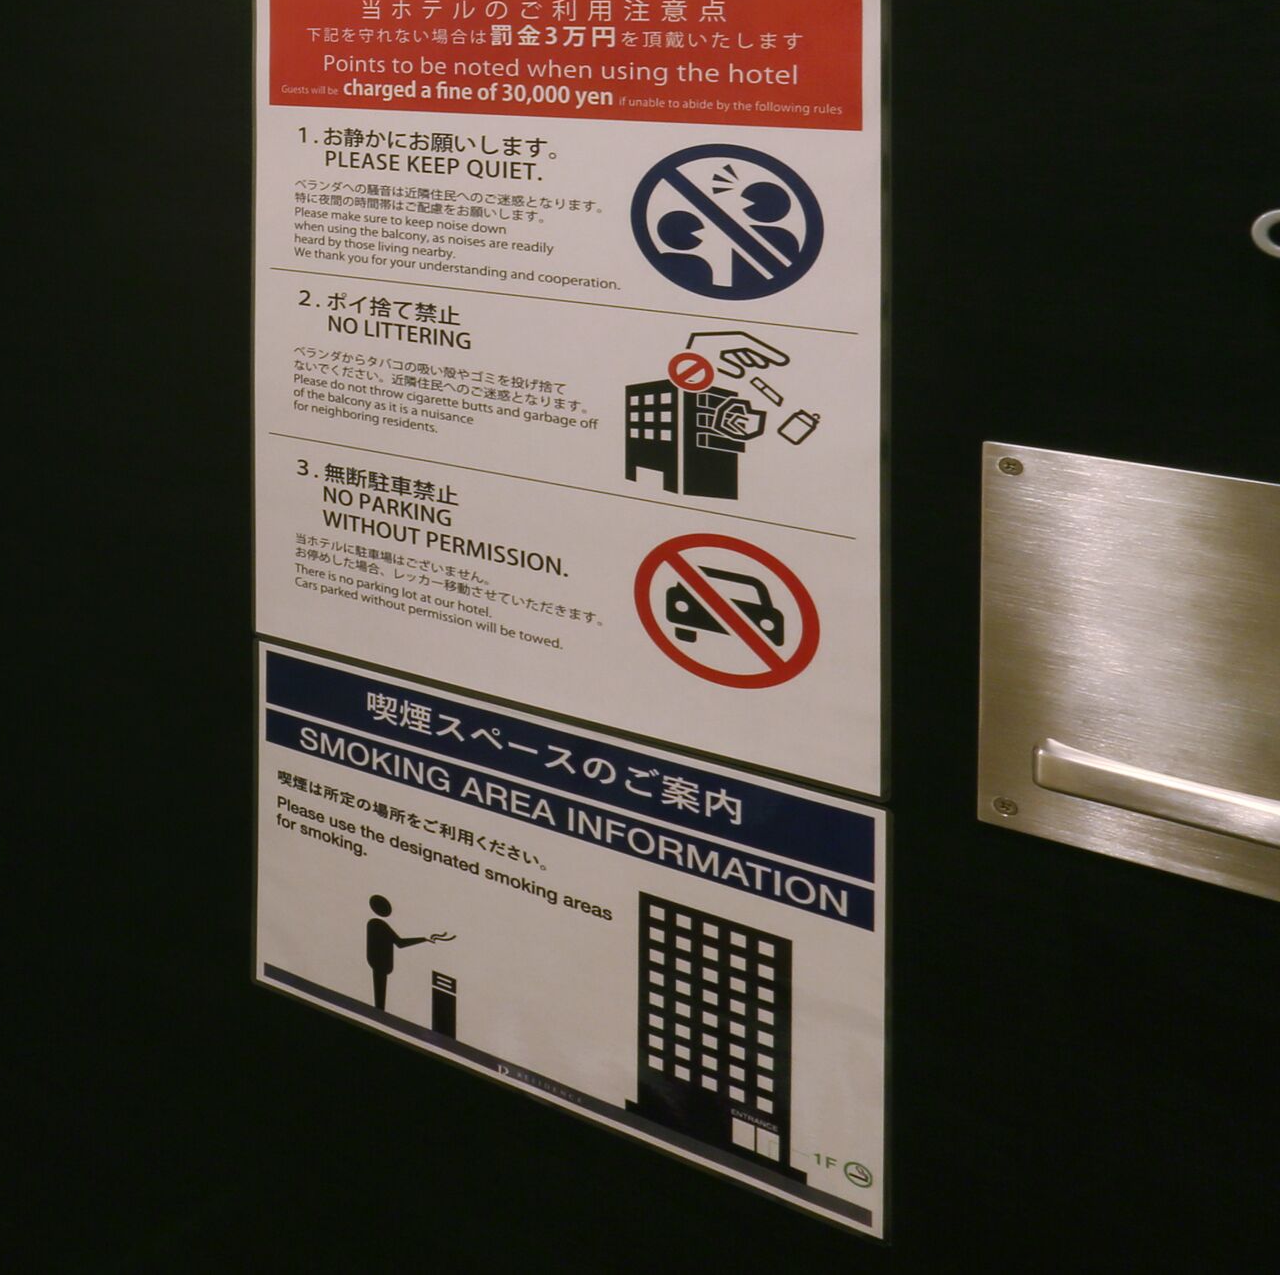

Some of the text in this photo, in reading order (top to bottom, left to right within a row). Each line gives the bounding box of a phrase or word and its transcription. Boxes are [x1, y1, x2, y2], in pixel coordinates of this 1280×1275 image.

[362, 0, 726, 22] 当ホテルのご利用注意点
[324, 55, 797, 86] Points to be noted when using the hotel
[343, 79, 416, 101] charged
[421, 85, 431, 98] a
[436, 81, 472, 100] fine
[477, 82, 498, 101] of
[502, 84, 570, 105] 30,000
[575, 91, 613, 109] yen
[619, 96, 626, 106] if
[629, 98, 665, 108] unable
[668, 100, 680, 108] to
[682, 99, 713, 109] abide
[716, 100, 730, 112] by
[733, 101, 752, 111] the
[755, 101, 810, 116] following
[814, 104, 843, 115] rules
[326, 150, 542, 181] PLEASE KEEP QUIET.
[294, 222, 554, 256] when using the balcony, as noises are readily
[295, 207, 506, 234] Please make sure to keep noise down
[294, 234, 456, 261] heard by those living nearby.
[294, 247, 621, 290] We thank you for your understanding and cooperation.
[329, 315, 471, 349] NO LITTERING
[294, 374, 599, 429] Please do not throw cigarette butts and garbage off
[294, 388, 474, 425] of the balcony as it is a nuisance
[294, 401, 438, 433] for neighboring residents.
[324, 486, 451, 526] NO PARKING
[323, 510, 568, 577] WITHOUT PERMISSION.
[295, 563, 492, 618] There is no parking lot at our hotel.
[295, 577, 563, 649] Cars parked without permission will be towed.
[367, 692, 741, 825] 喫煙スペースのご案内
[276, 814, 367, 857] for smoking.
[299, 728, 850, 917] SMOKING AREA INFORMATION
[277, 795, 612, 921] Please use the designated smoking areas
[730, 1108, 778, 1132] ENTRANCE
[814, 1153, 838, 1169] 1F
